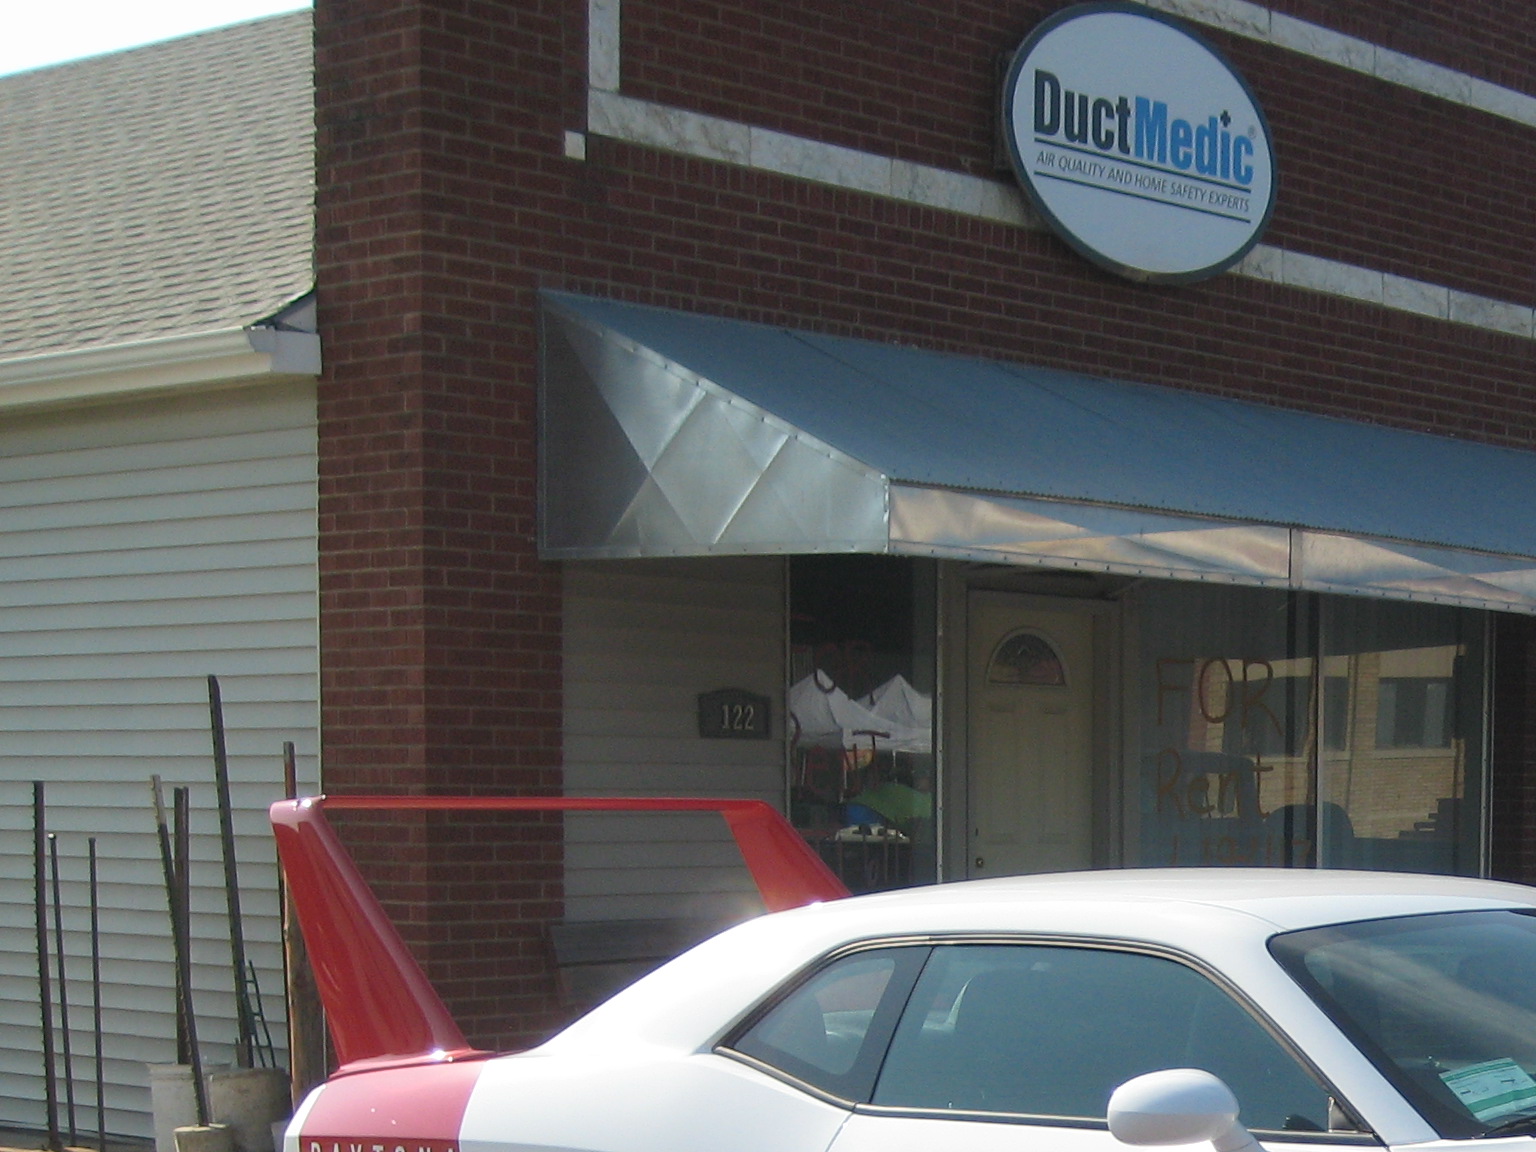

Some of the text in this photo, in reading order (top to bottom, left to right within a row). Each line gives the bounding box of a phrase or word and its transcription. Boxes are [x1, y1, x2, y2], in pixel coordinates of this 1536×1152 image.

[1033, 68, 1254, 186] DuctMedic
[1036, 150, 1250, 213] AIR QUALITY AND HOME SAFETY EXPERTS
[722, 704, 754, 730] 122
[1156, 655, 1286, 737] FOR
